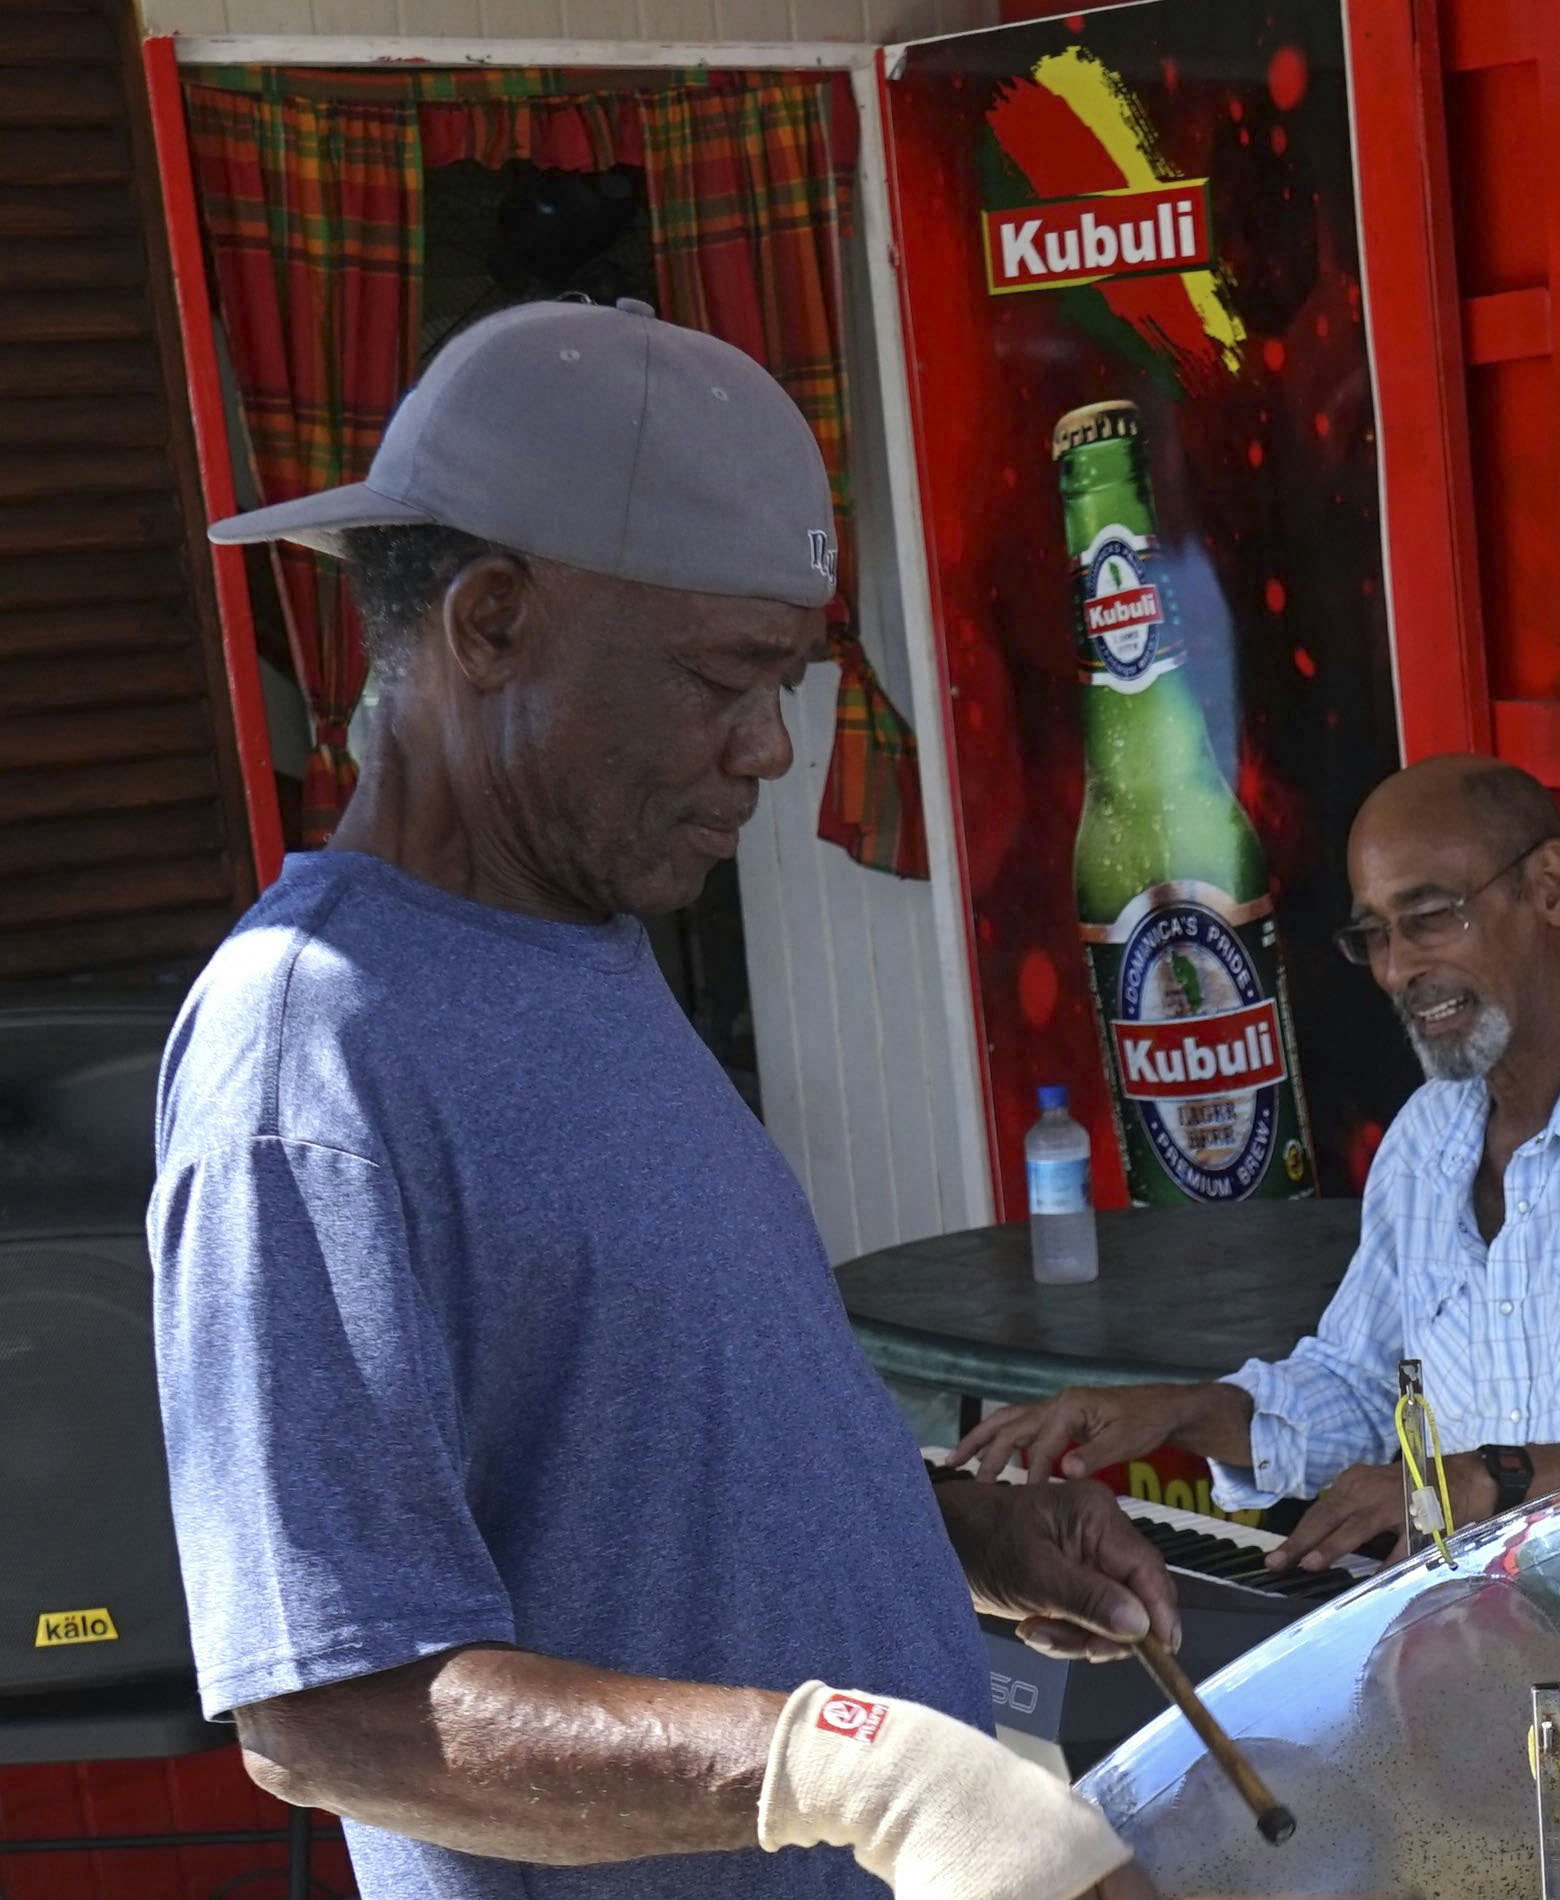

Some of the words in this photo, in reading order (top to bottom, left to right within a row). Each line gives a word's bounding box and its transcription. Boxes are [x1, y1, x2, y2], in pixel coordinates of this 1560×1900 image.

[1001, 200, 1196, 278] Kubuli
[1089, 593, 1157, 629] Kubuli
[1127, 916, 1199, 1006] DOMINICA'S
[1206, 925, 1250, 991] PRIDE
[1122, 1022, 1274, 1083] Kubuli
[1155, 1132, 1232, 1197] PREMIUM
[1236, 1120, 1271, 1185] BREW
[45, 1615, 108, 1641] kälo
